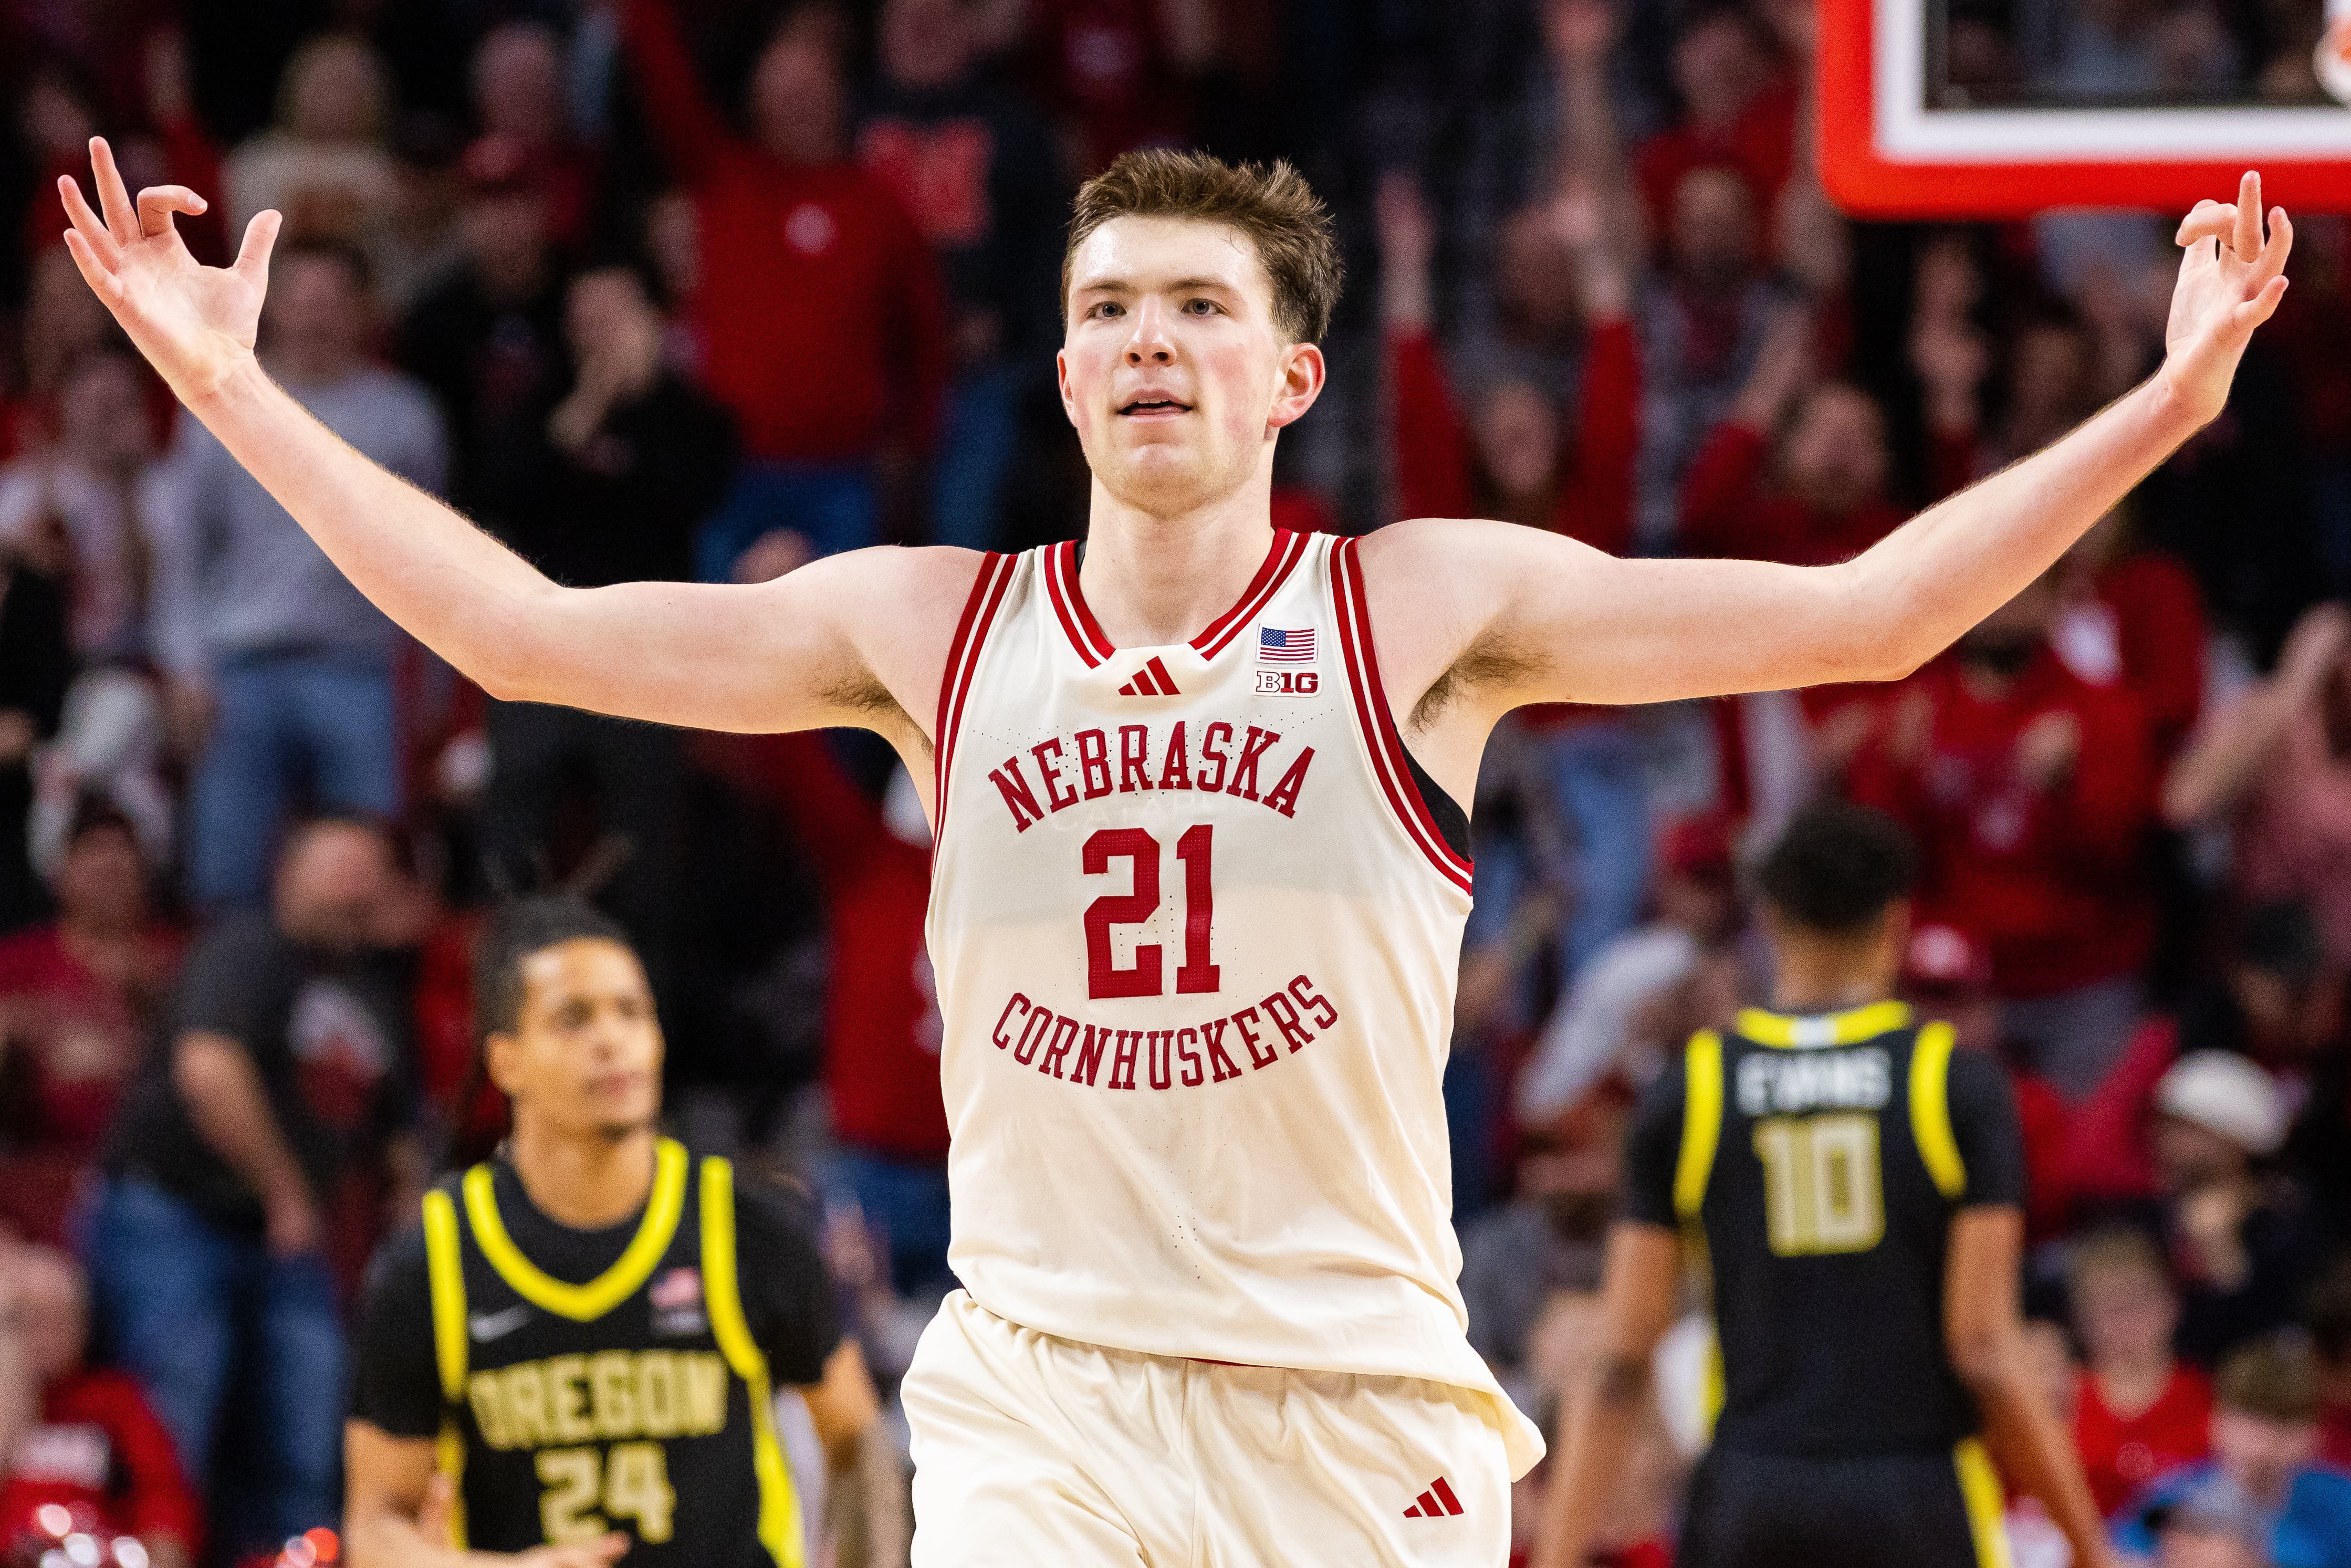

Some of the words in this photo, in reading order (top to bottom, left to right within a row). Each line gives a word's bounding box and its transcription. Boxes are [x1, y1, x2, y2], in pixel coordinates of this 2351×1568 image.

[988, 721, 1315, 833] NEBRASKA
[1082, 824, 1220, 1000] 21
[992, 975, 1339, 1091] CORNHUSKERS
[1752, 1112, 1886, 1256] 10
[471, 1350, 727, 1450] OREGON
[535, 1441, 676, 1544] 24
